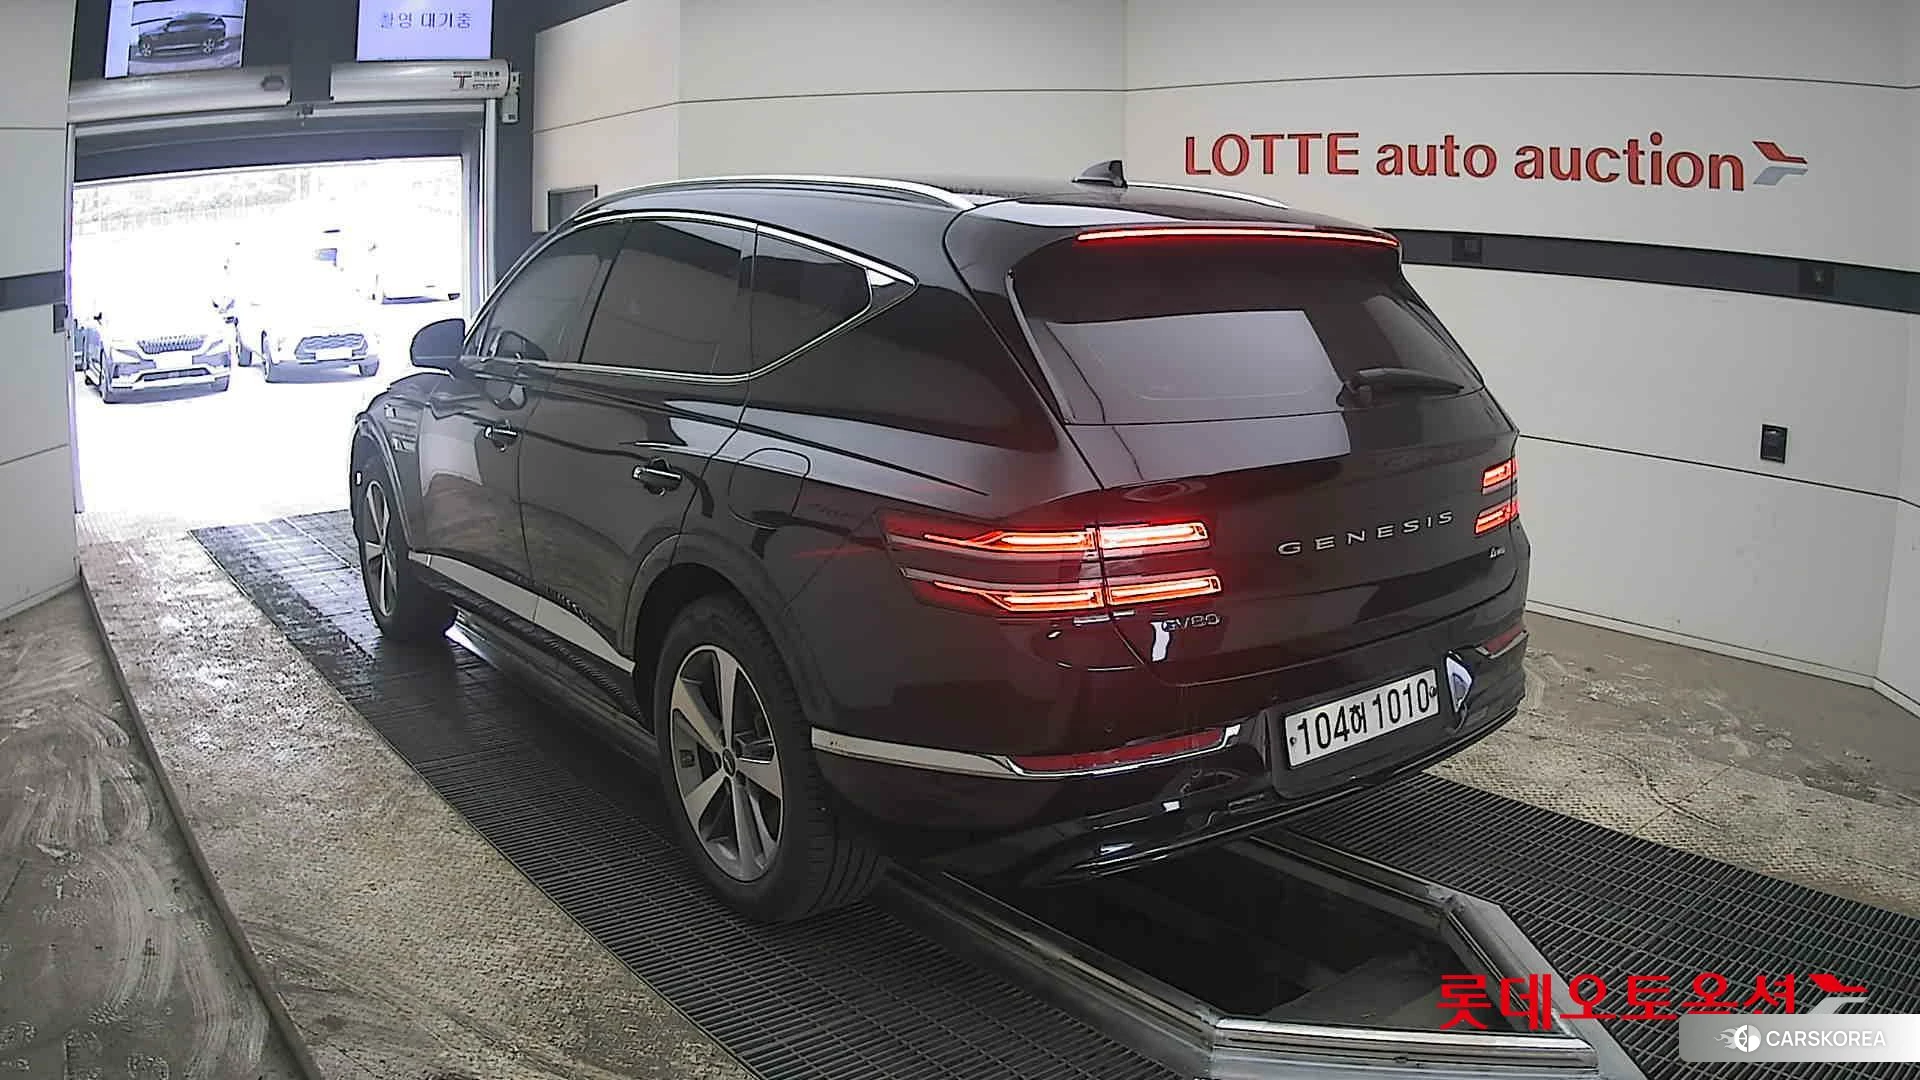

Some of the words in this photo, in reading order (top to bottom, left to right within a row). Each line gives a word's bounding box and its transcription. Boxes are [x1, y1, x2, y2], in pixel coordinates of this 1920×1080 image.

[421, 11, 472, 29] 대기중
[1185, 132, 1360, 177] LOTTE
[1376, 134, 1497, 178] auto
[1514, 131, 1745, 192] auction
[1277, 511, 1454, 555] GENESIS
[1162, 612, 1220, 631] GV80
[1297, 700, 1368, 755] 104허
[1372, 678, 1430, 729] 1010
